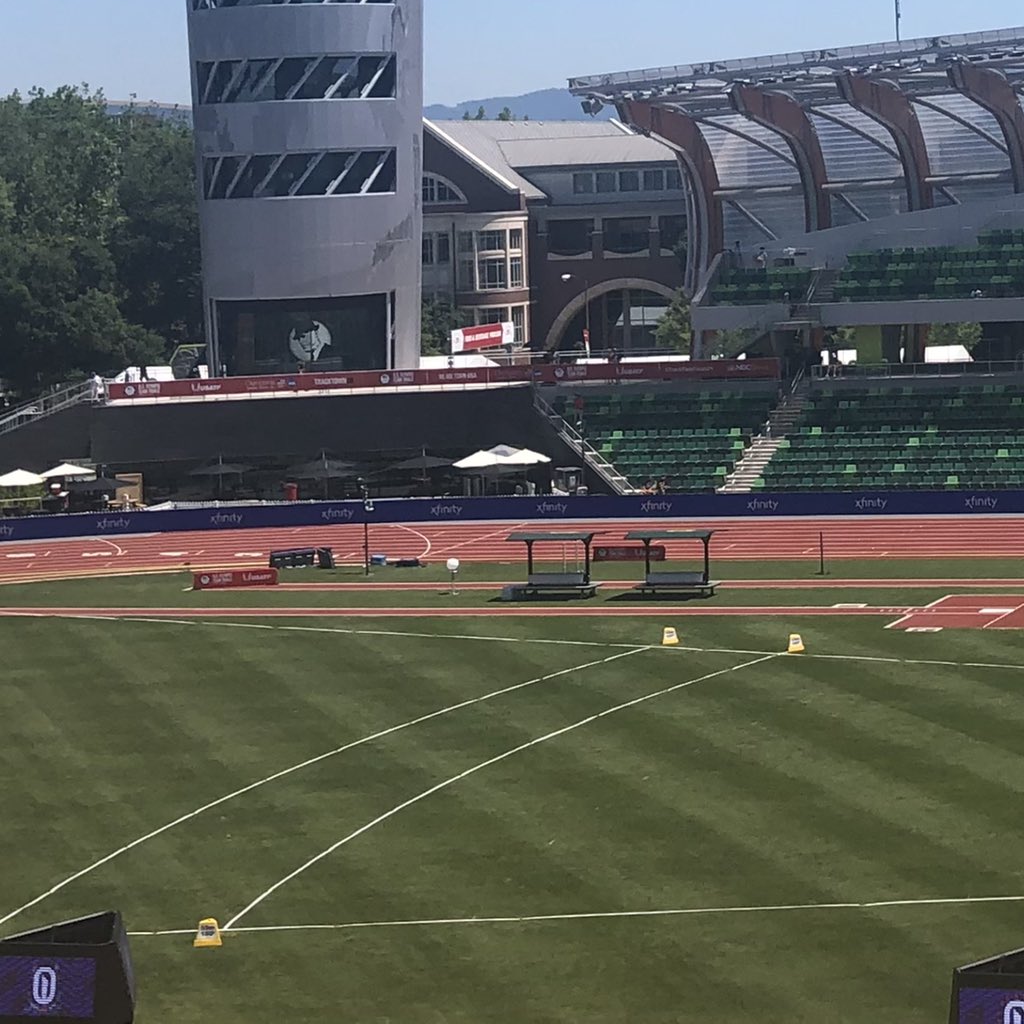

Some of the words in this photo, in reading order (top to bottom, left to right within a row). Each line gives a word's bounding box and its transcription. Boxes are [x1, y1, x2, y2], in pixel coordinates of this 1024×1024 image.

[537, 501, 568, 514] xfinity
[641, 500, 673, 513] xfinity
[747, 498, 779, 511] xfinity
[855, 497, 887, 510] xfinity
[965, 496, 997, 508] xfinity
[322, 508, 354, 519] xfinity
[431, 503, 462, 516] xfinity
[97, 517, 130, 529] xfinity
[211, 512, 242, 524] xfinity
